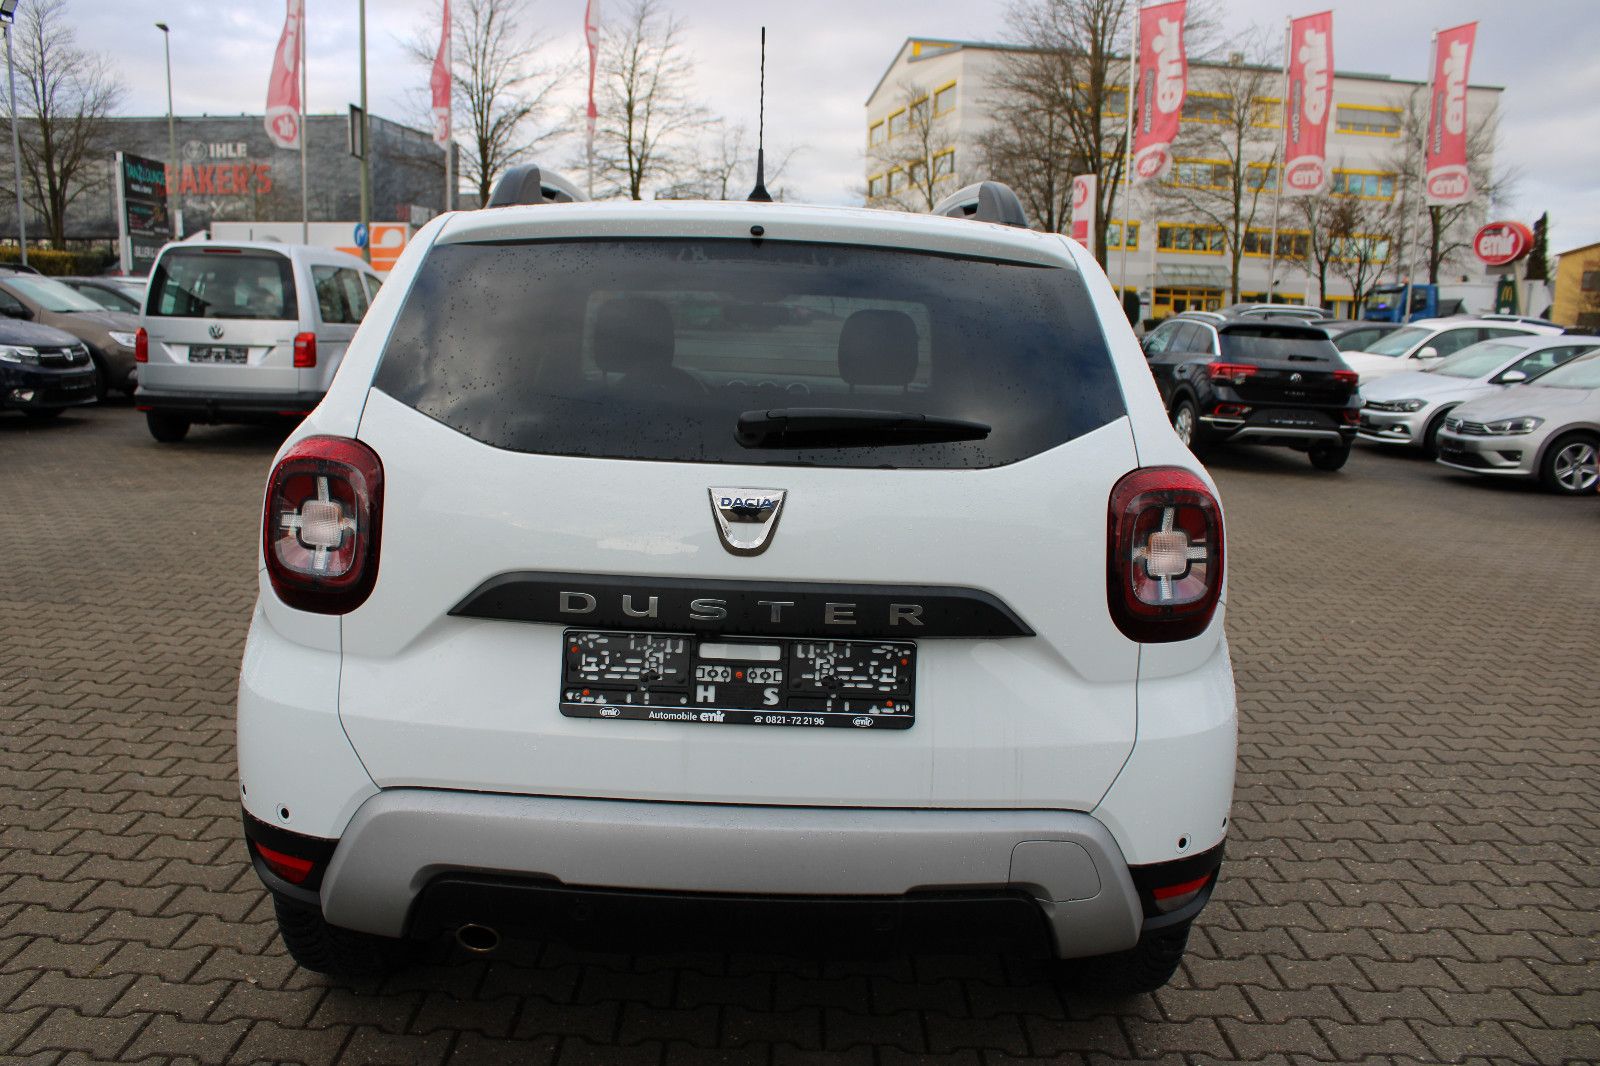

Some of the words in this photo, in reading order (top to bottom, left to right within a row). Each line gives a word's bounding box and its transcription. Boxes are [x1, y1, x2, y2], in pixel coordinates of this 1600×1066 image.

[1152, 18, 1184, 114] emir
[1298, 28, 1328, 126] emir
[1443, 40, 1469, 135] emir
[209, 142, 248, 158] IHLE
[165, 163, 272, 195] BAKER'S
[1479, 225, 1516, 256] emir
[720, 497, 773, 508] DACIA
[559, 591, 924, 626] DUSTER
[648, 710, 698, 722] Automobile
[699, 710, 726, 723] emir
